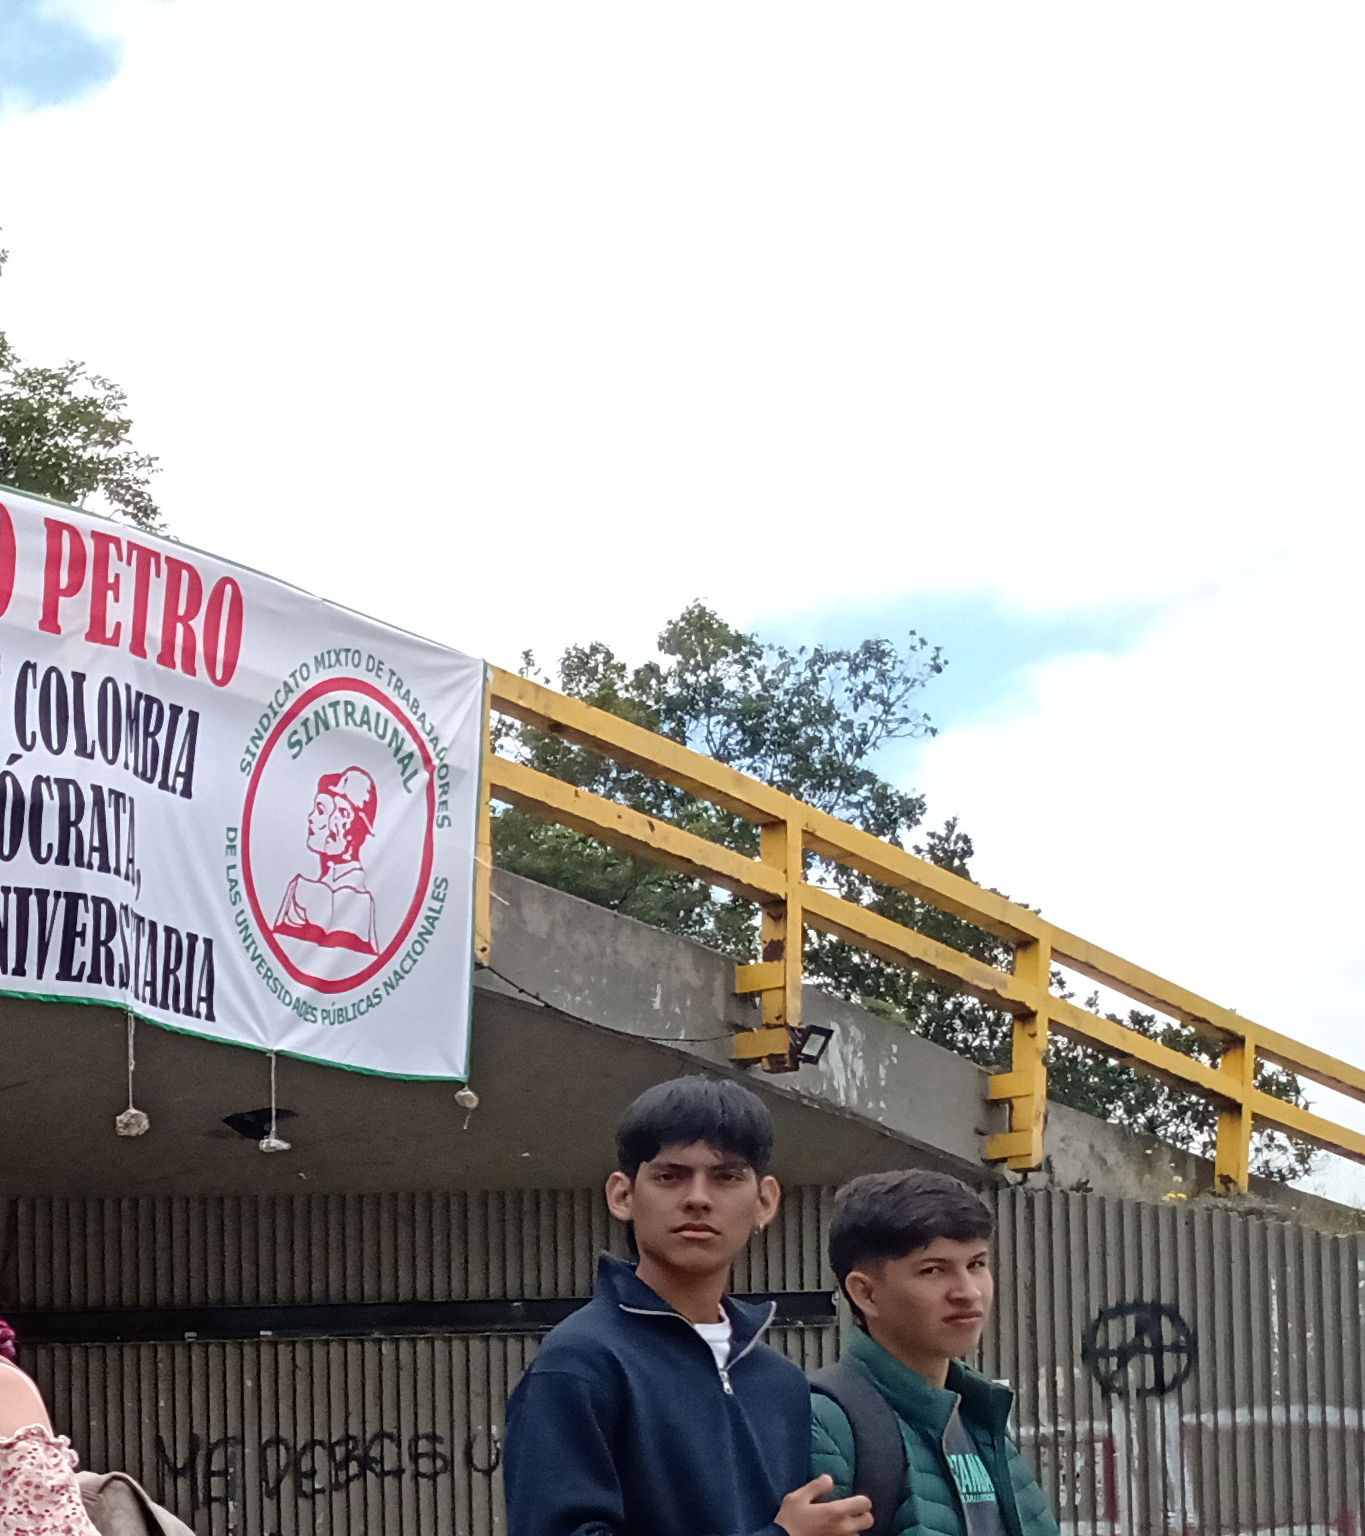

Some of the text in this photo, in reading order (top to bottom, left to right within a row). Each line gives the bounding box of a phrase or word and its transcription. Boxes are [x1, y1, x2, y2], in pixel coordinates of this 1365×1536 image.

[39, 517, 245, 688] PETRO
[14, 659, 200, 800] COLOMBIA
[239, 647, 451, 830] SINDICATO MIXTO DE TRABAJADORES
[286, 700, 419, 794] SINTRAUNAL
[225, 826, 449, 1026] DE LAS UNIVERSIDADES PÚBLICAS NACIONALES
